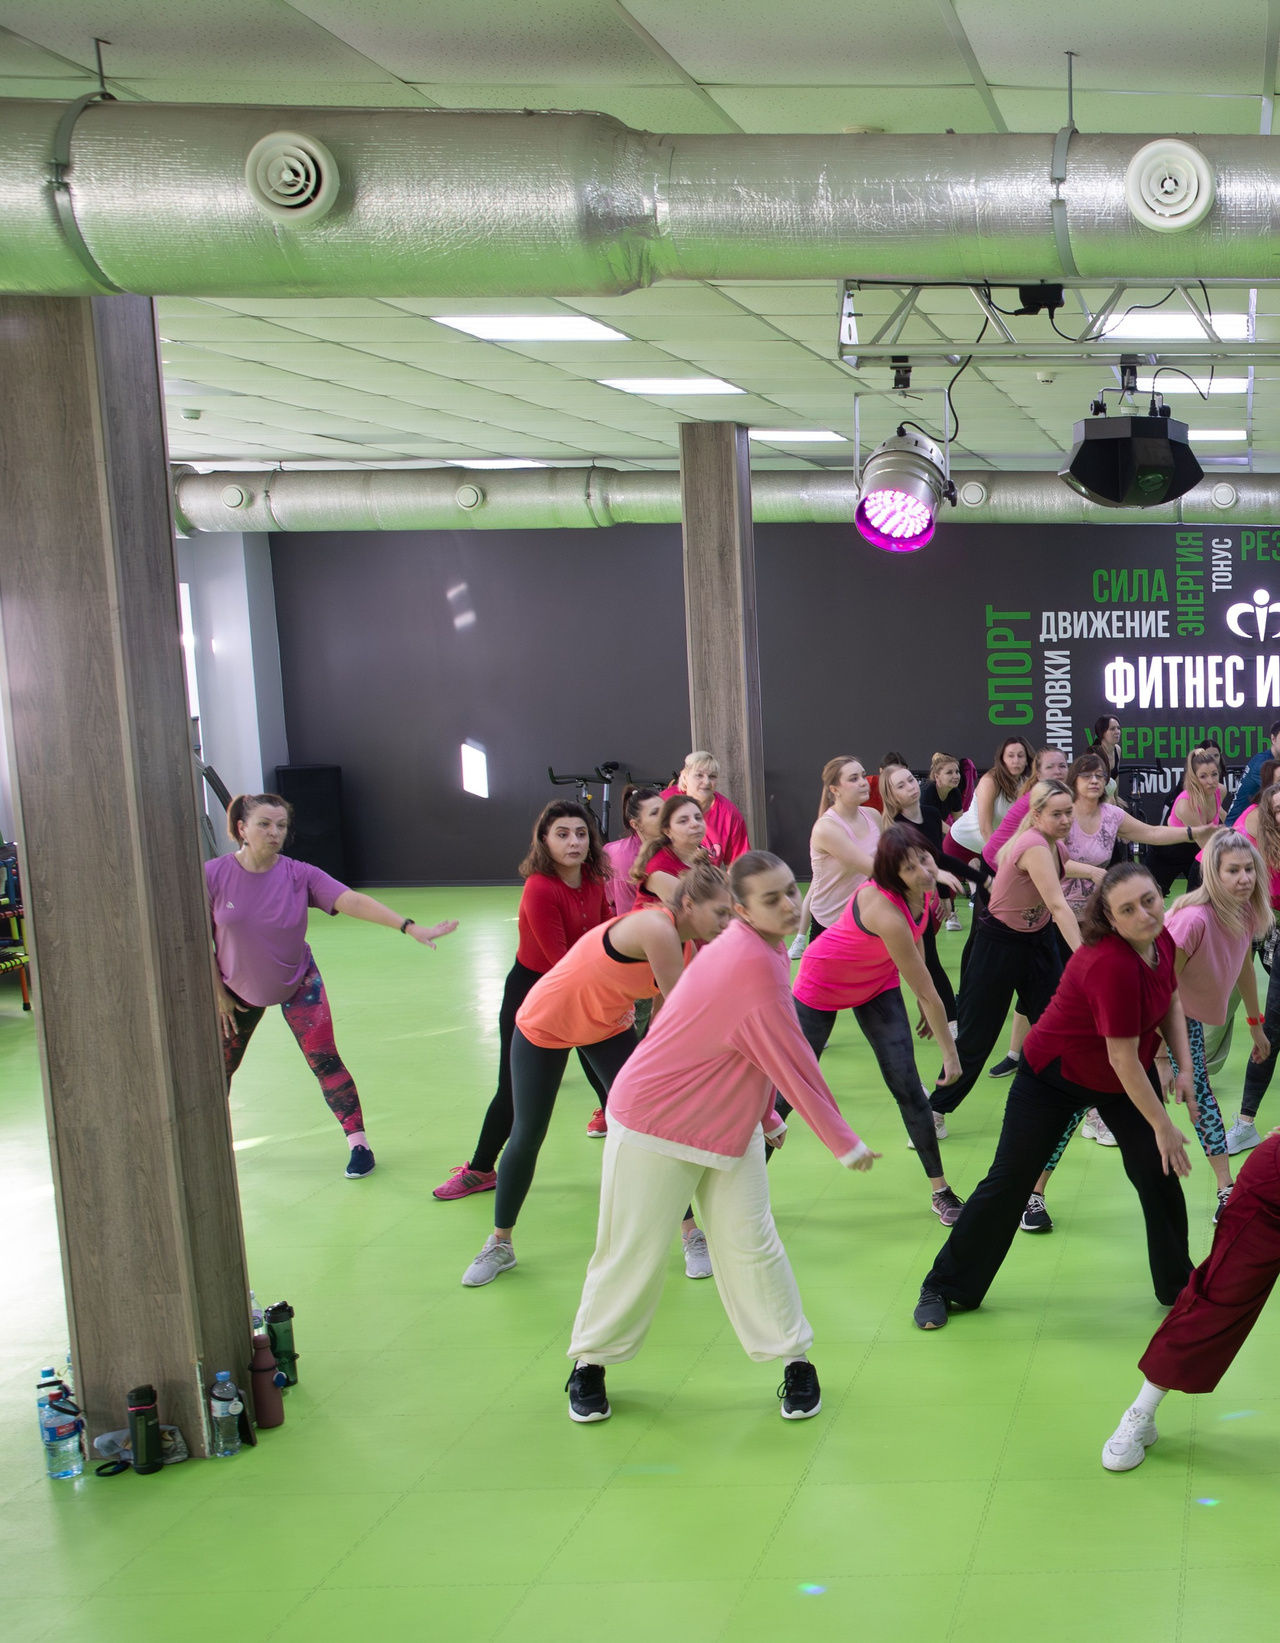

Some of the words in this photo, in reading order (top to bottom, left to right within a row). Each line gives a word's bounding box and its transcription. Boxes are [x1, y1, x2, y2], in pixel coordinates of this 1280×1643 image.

[1092, 568, 1169, 603] СИЛА
[1175, 532, 1205, 637] ЭНЕРГИЯ
[1211, 538, 1232, 593] ТОНУС
[1039, 610, 1170, 643] ДВИЖЕНИЕ
[985, 604, 1034, 726] СПОРТ
[1104, 655, 1245, 709] ФИТНЕС
[1044, 650, 1073, 763] НИРОВКИ
